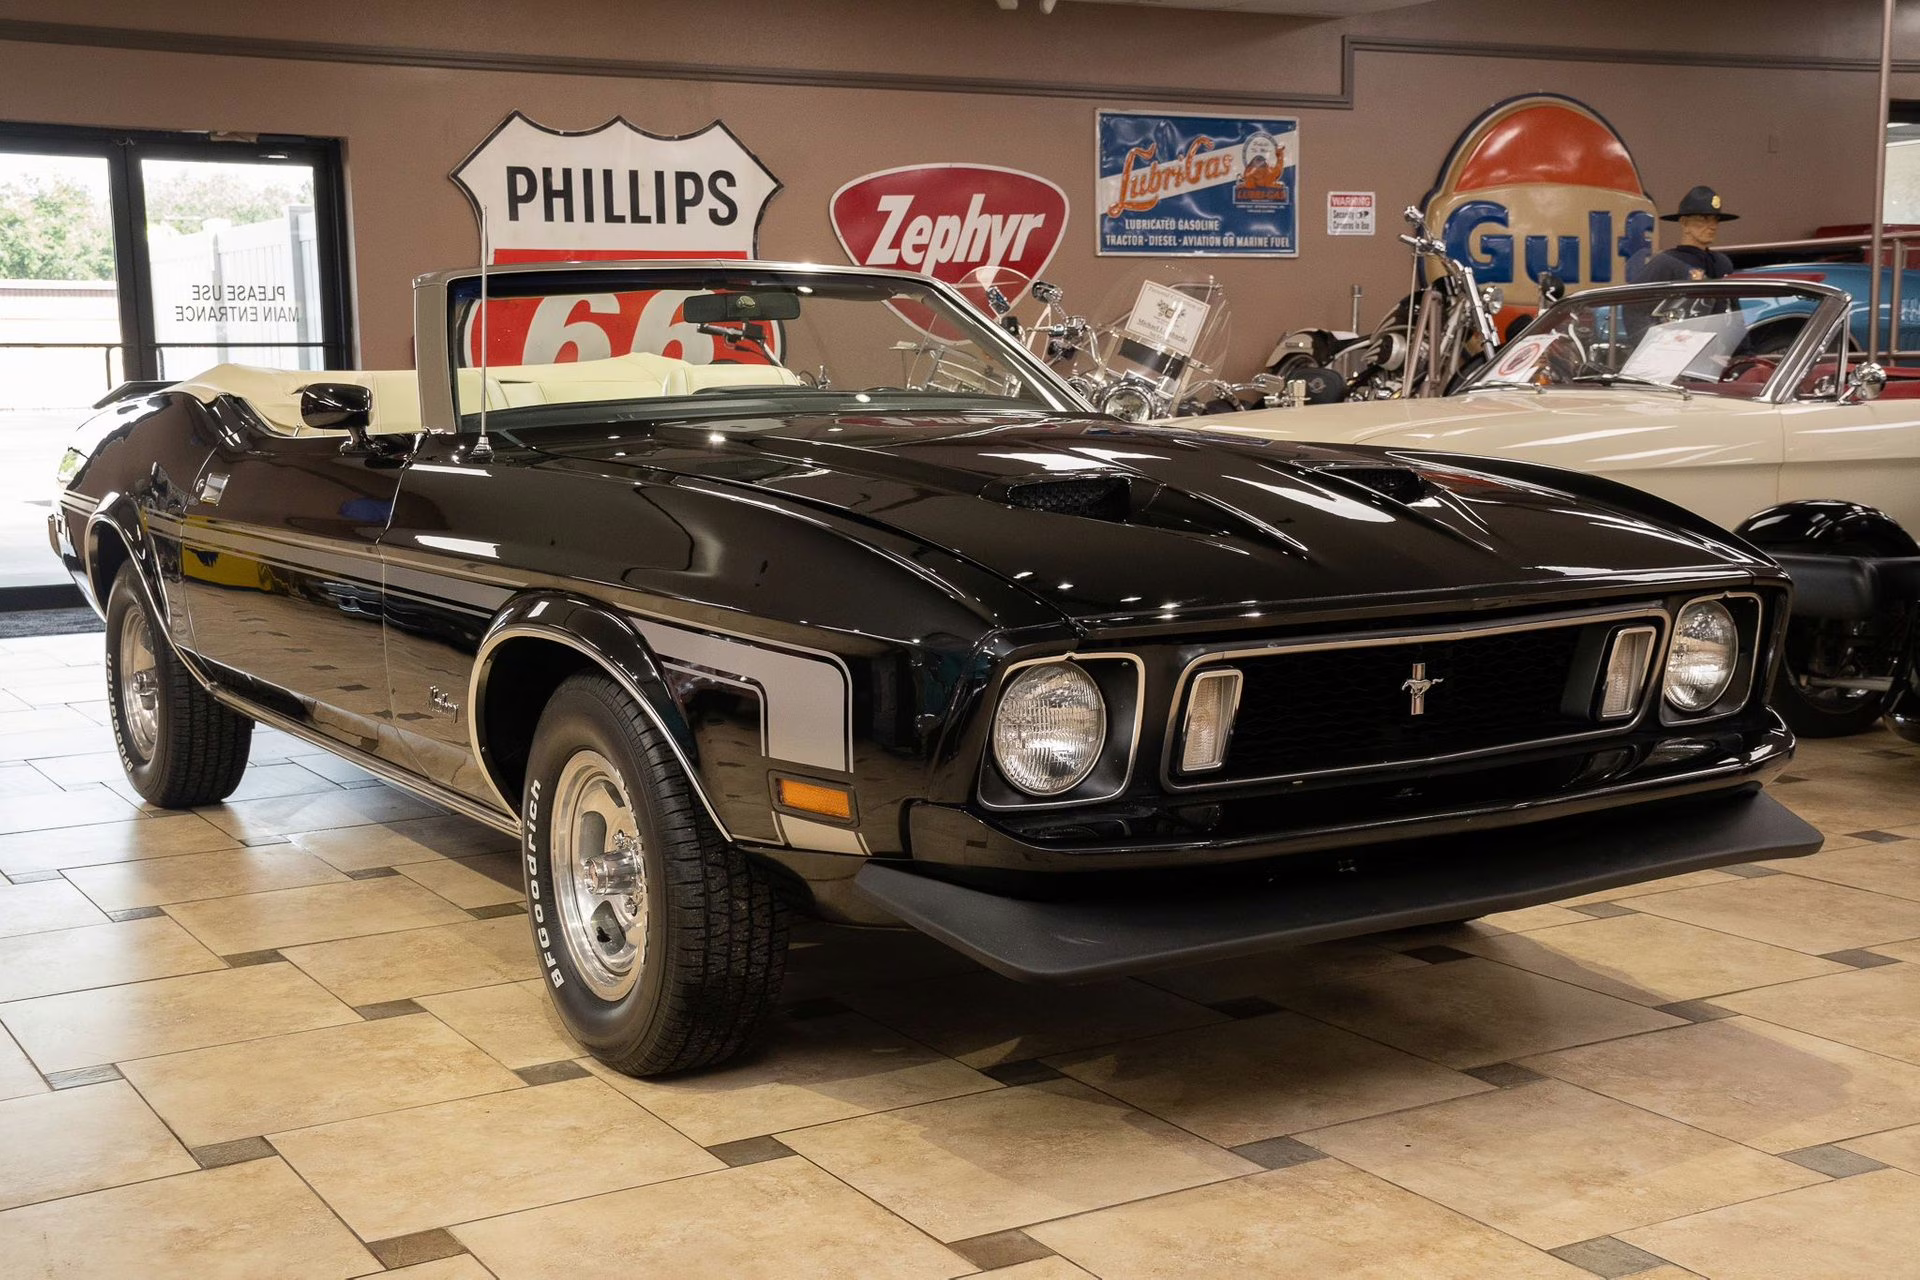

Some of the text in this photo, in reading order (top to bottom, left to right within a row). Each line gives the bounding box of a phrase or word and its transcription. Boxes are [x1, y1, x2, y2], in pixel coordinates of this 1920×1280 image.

[506, 166, 739, 227] PHILLIPS
[1125, 218, 1220, 231] LUBRICATED GASOLINE
[865, 193, 1047, 290] Zephyr
[1106, 235, 1290, 247] TRACTOR DIESEL AVIATION OR MARINE FUEL
[1442, 201, 1656, 284] Gulf
[522, 289, 715, 366] 66
[105, 652, 134, 773] BFGoodrich
[526, 779, 565, 989] BFGoodrich
